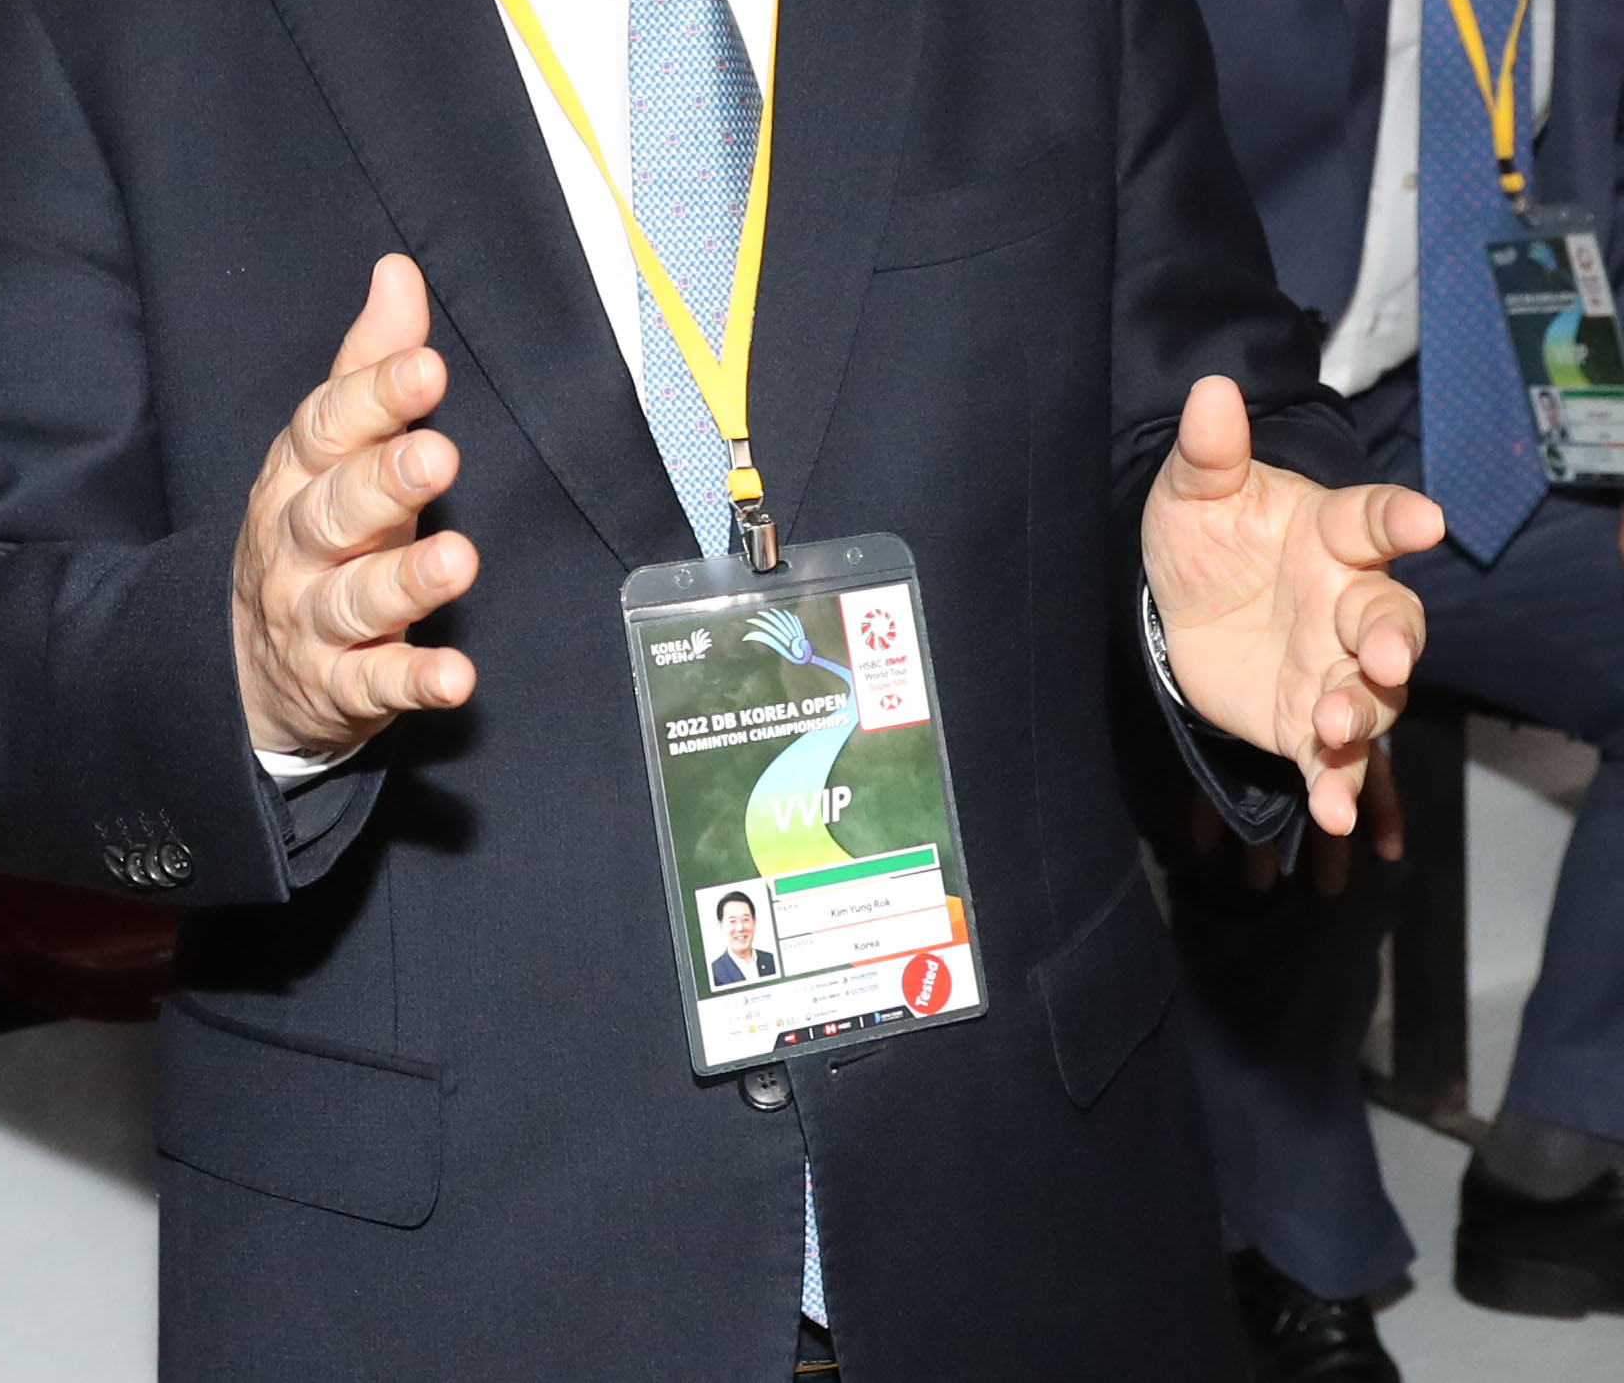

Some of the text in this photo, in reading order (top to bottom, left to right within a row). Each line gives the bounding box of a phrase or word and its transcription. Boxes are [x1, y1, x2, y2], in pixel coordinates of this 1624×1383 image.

[650, 639, 691, 656] KOREA
[655, 651, 688, 666] OPEN
[665, 692, 848, 740] 2022 DB KOREA OPEN
[668, 712, 851, 756] BADMINTON CHAMPIONSHIPS
[770, 785, 853, 833] VVIP
[830, 898, 892, 918] Kim Yung Rok
[854, 940, 881, 952] Korea
[914, 958, 940, 1007] Tested
